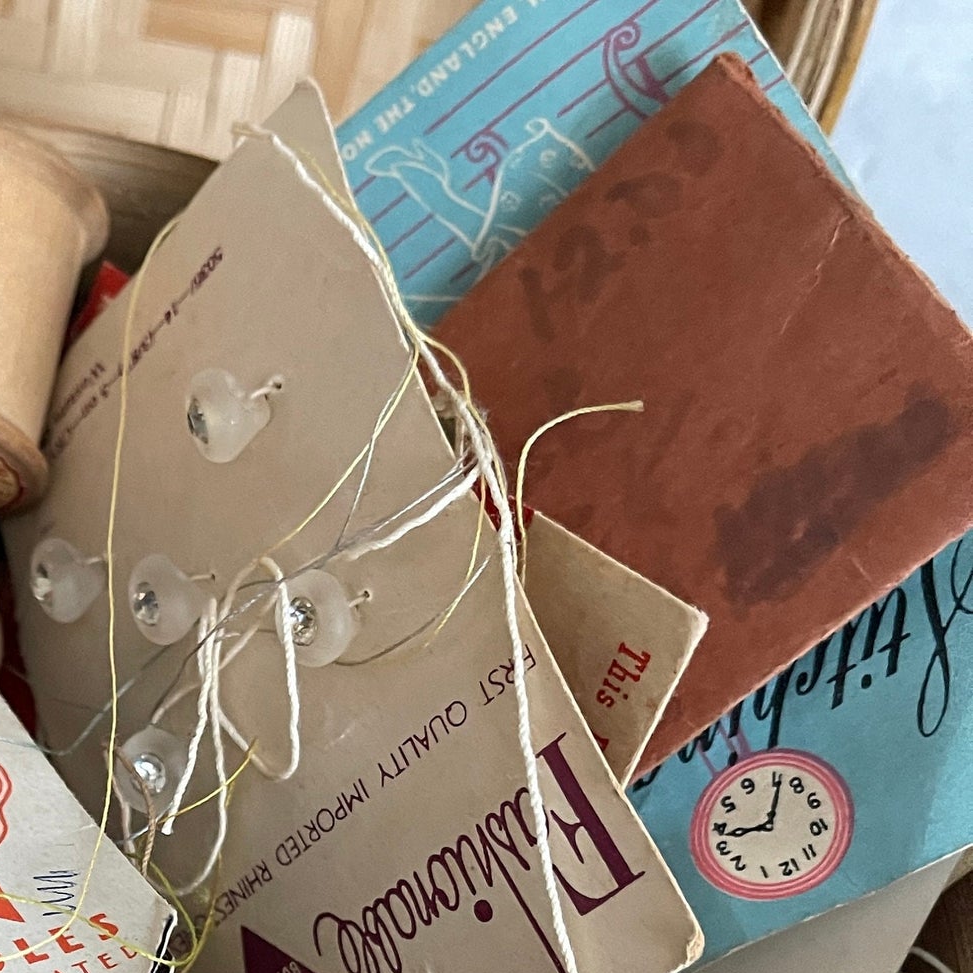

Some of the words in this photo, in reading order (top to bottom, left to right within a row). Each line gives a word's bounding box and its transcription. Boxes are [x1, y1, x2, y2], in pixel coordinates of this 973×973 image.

[373, 95, 416, 134] THE
[477, 644, 536, 706] FRST
[596, 642, 651, 708] This
[377, 700, 467, 788] QUALITY
[740, 778, 755, 795] 6
[789, 776, 805, 794] 8
[720, 795, 736, 814] 5
[807, 792, 821, 809] 9
[276, 778, 370, 866] IMPORTED
[809, 818, 829, 836] 10
[716, 840, 732, 856] 3
[729, 855, 746, 871] 2
[778, 858, 800, 876] 12
